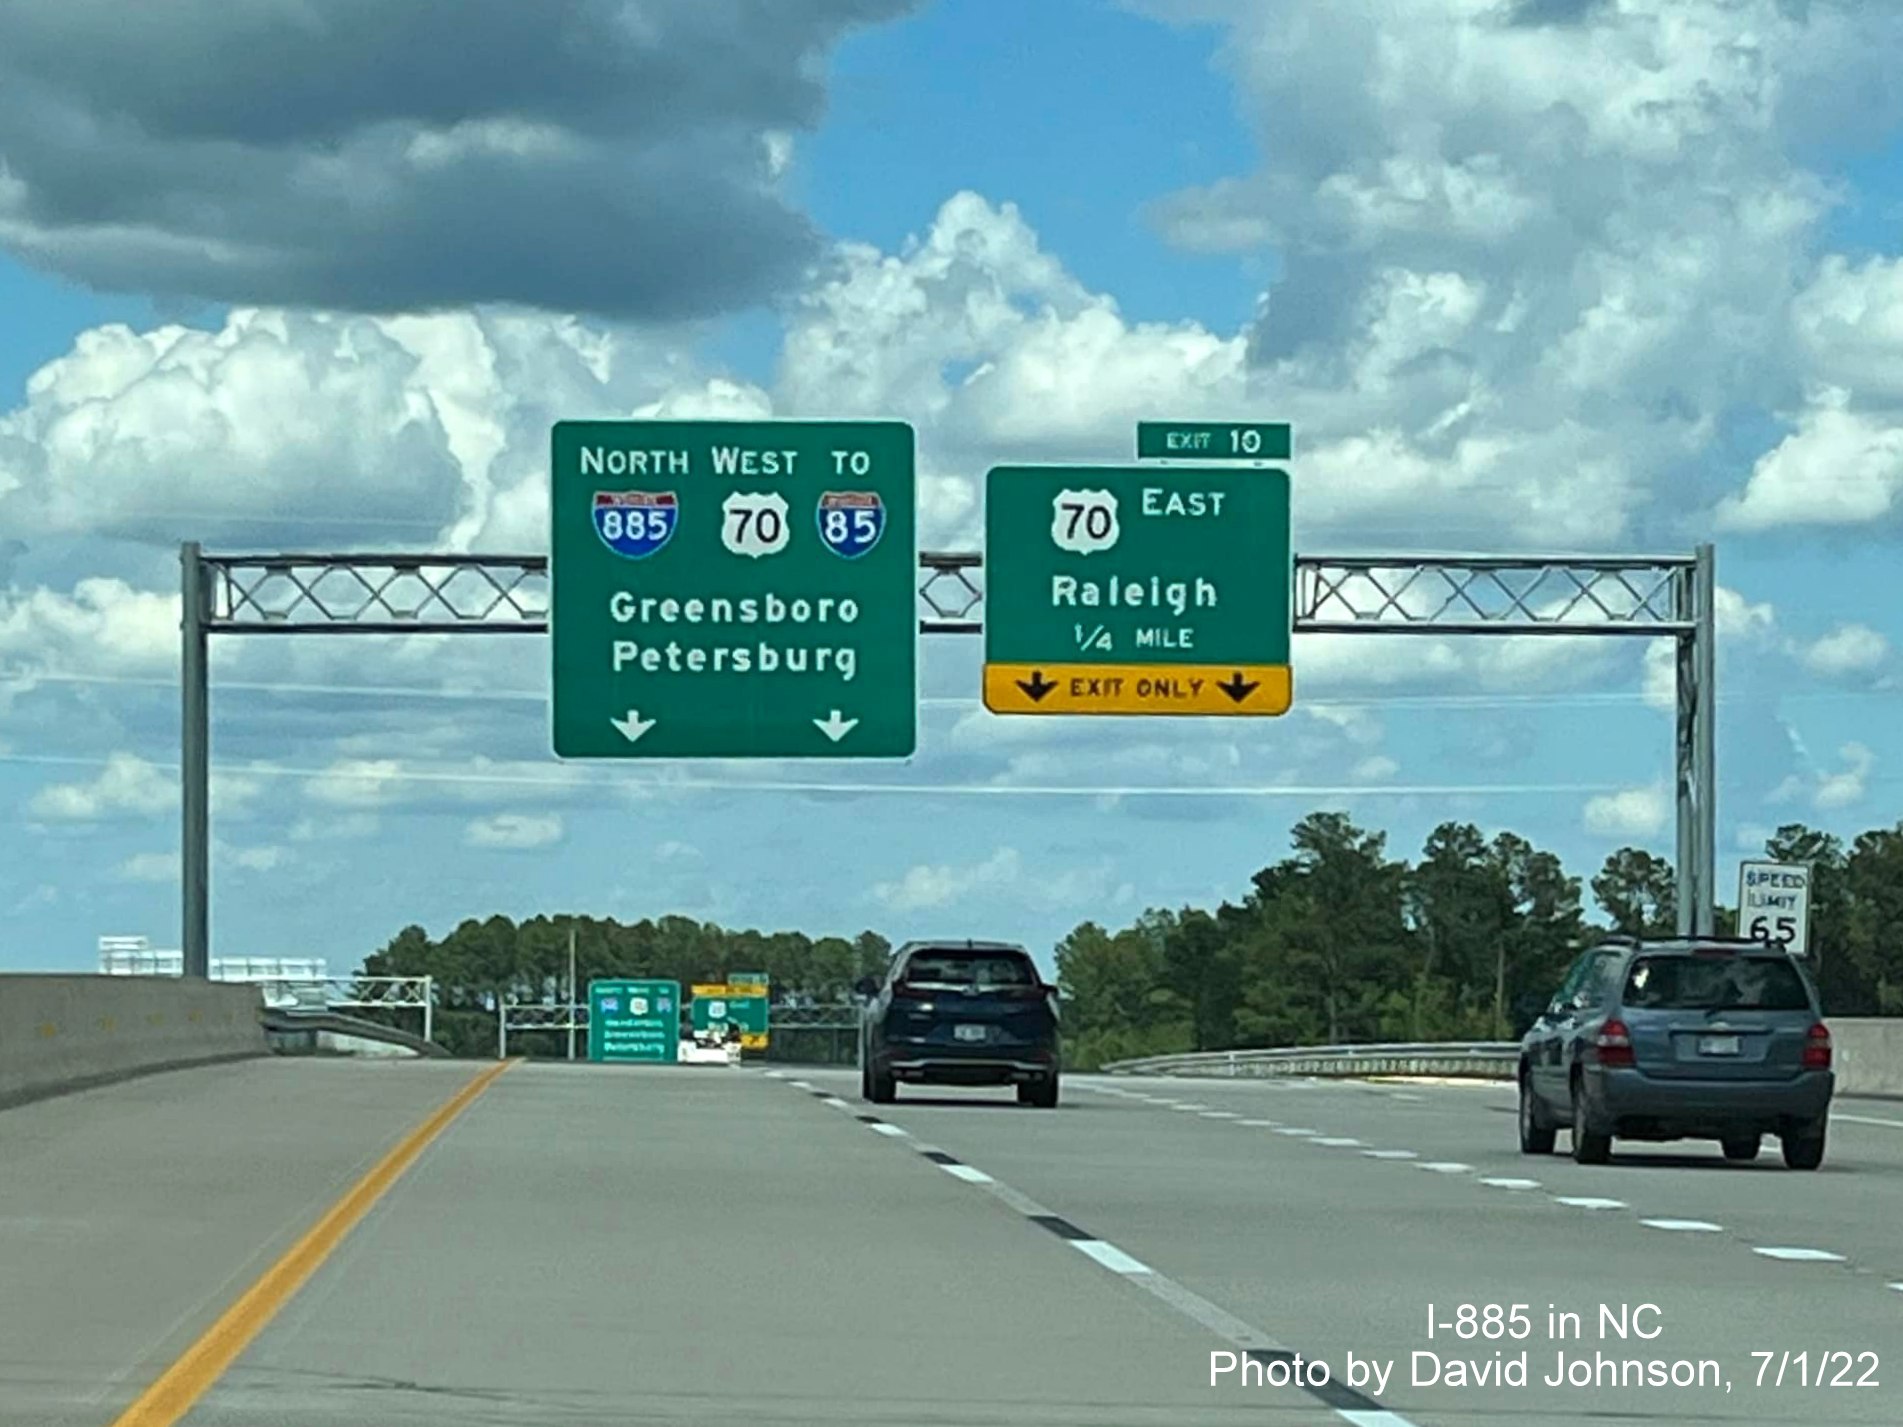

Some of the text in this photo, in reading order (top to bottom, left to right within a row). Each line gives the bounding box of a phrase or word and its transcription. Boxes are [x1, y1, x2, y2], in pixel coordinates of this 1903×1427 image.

[1166, 430, 1261, 453] EXIT 10
[580, 446, 871, 475] NORTH WEST TO
[603, 508, 876, 544] 885 70 85
[1061, 488, 1226, 540] 70 EAST
[610, 591, 859, 623] Greensboro
[1052, 575, 1218, 616] Raleigh
[1136, 628, 1194, 648] MILE
[613, 641, 855, 681] Petersburg
[1070, 677, 1205, 698] EXIT ONLY
[1747, 871, 1805, 888] SPEED
[1748, 892, 1797, 909] LIMIT
[1750, 916, 1797, 944] 65
